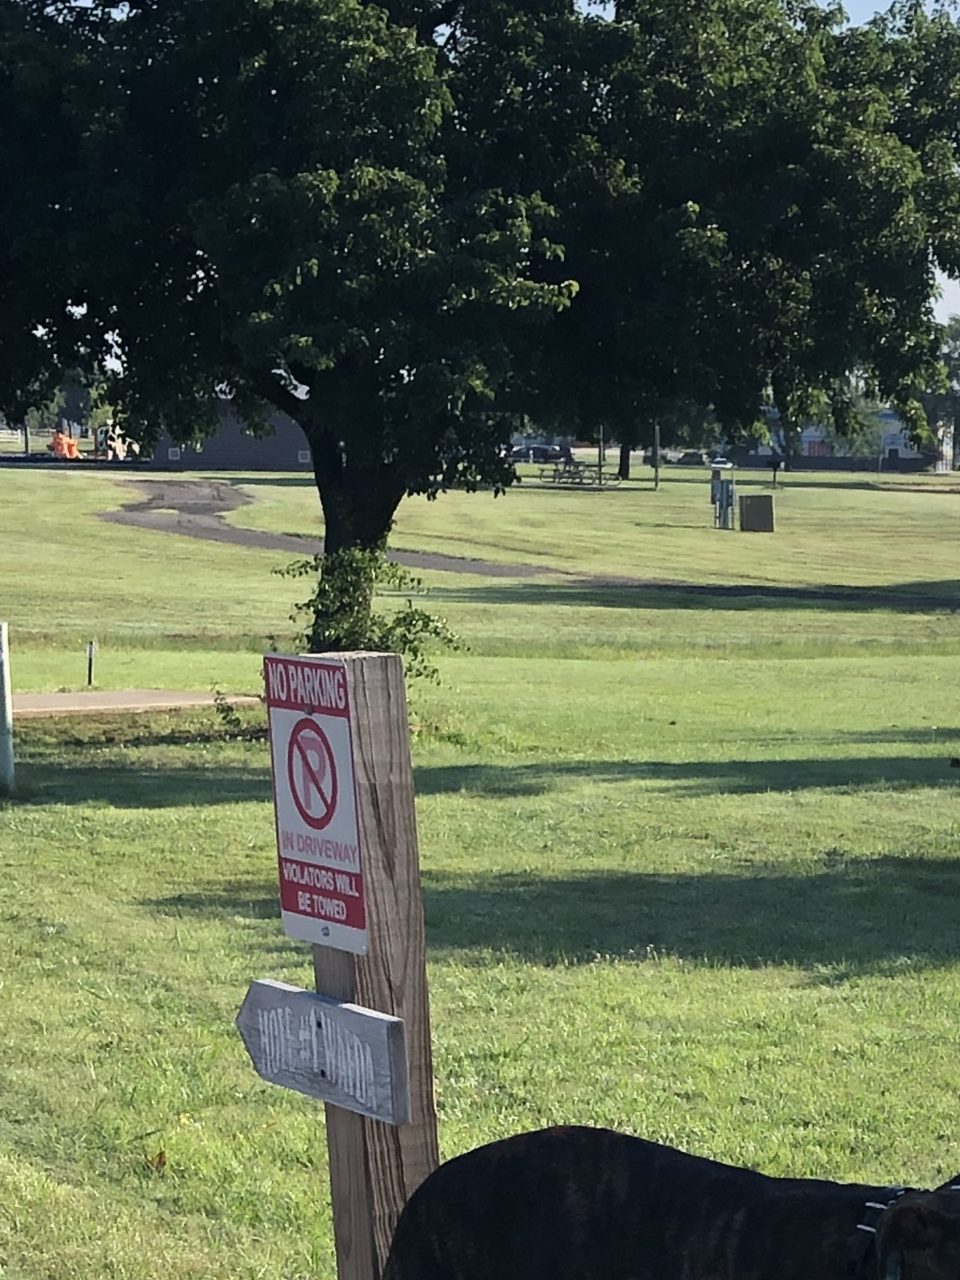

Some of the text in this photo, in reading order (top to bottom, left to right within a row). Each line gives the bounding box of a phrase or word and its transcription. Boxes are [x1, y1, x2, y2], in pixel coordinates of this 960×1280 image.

[267, 662, 345, 710] NO PARKING
[300, 735, 326, 811] P
[281, 830, 358, 865] IN DRIVEWAY
[282, 862, 360, 898] VIOLATORS WILL
[297, 891, 347, 921] BE TOWED
